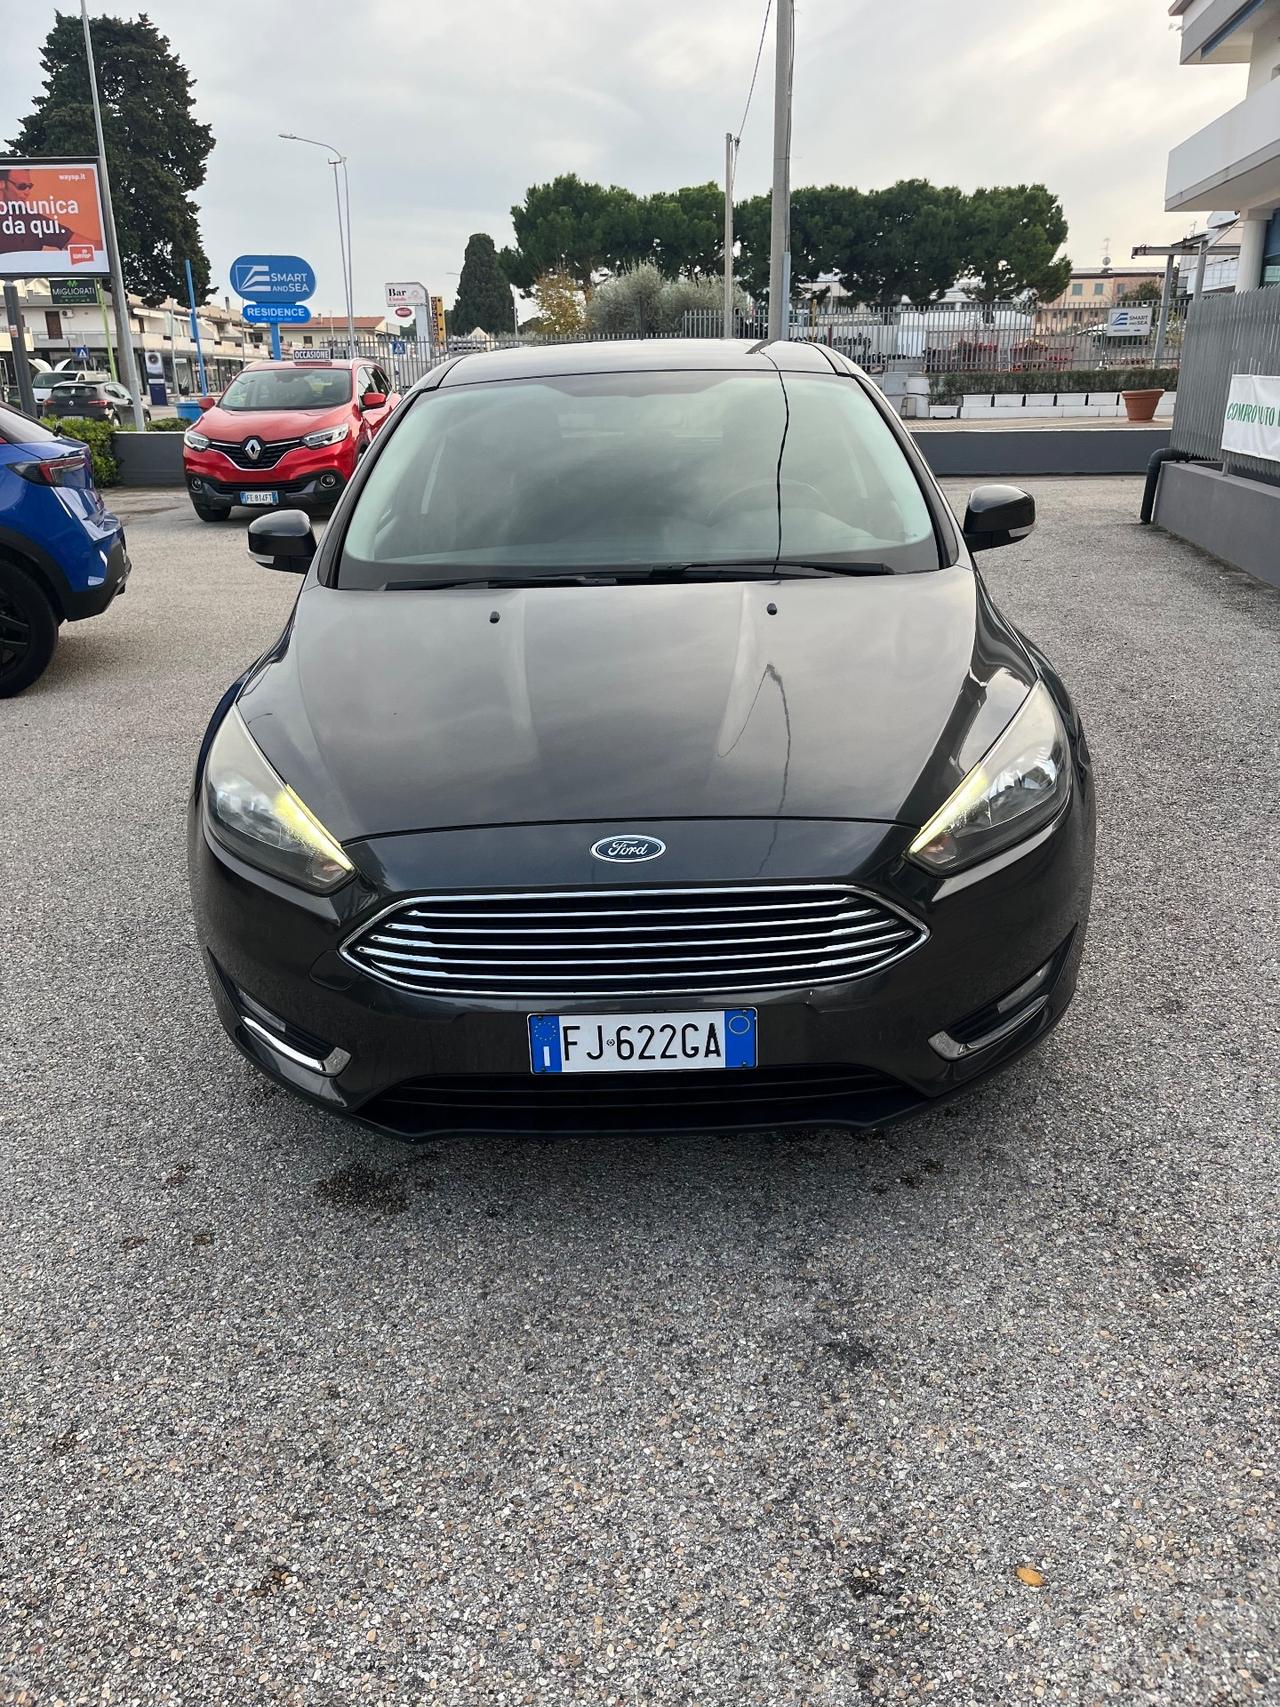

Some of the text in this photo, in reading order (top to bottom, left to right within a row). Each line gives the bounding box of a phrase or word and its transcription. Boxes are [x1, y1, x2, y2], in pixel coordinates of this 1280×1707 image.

[0, 195, 79, 215] omunica
[2, 215, 66, 238] da qui.
[270, 273, 308, 282] SMART
[52, 287, 95, 296] MIGLIORATI
[288, 283, 310, 292] SEA
[388, 288, 407, 297] Bar
[246, 307, 305, 317] RESIDENCE
[294, 350, 330, 359] OCCASIONE
[1226, 402, 1258, 423] COMPRO
[607, 840, 649, 856] Ford
